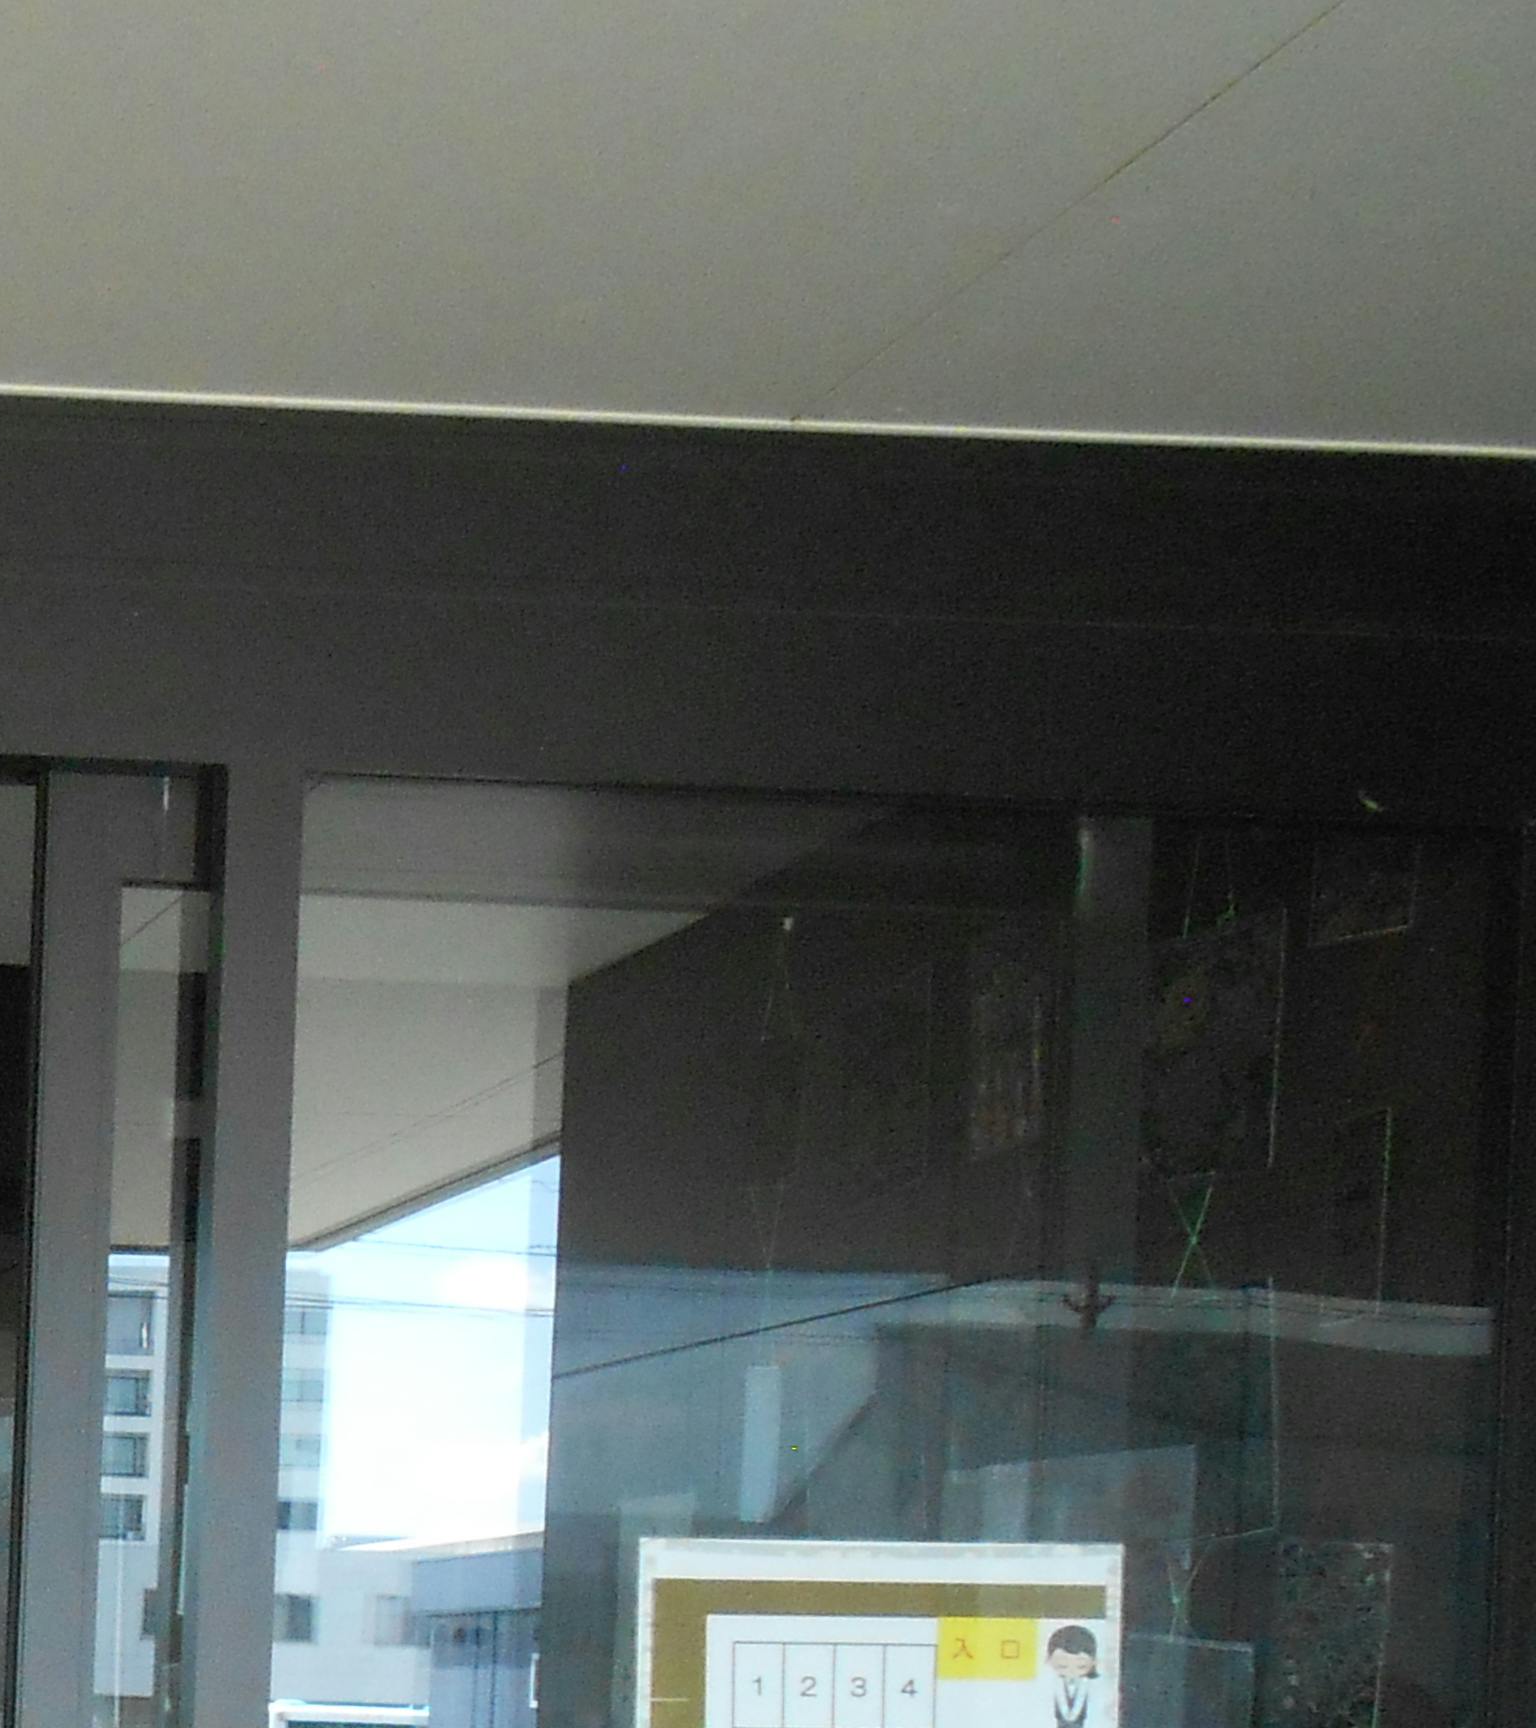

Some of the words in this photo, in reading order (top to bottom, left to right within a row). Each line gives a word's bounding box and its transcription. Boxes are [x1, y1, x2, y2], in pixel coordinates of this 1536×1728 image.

[752, 1676, 765, 1697] 1
[800, 1676, 817, 1697] 2
[851, 1677, 867, 1697] 3
[901, 1679, 918, 1698] 4
